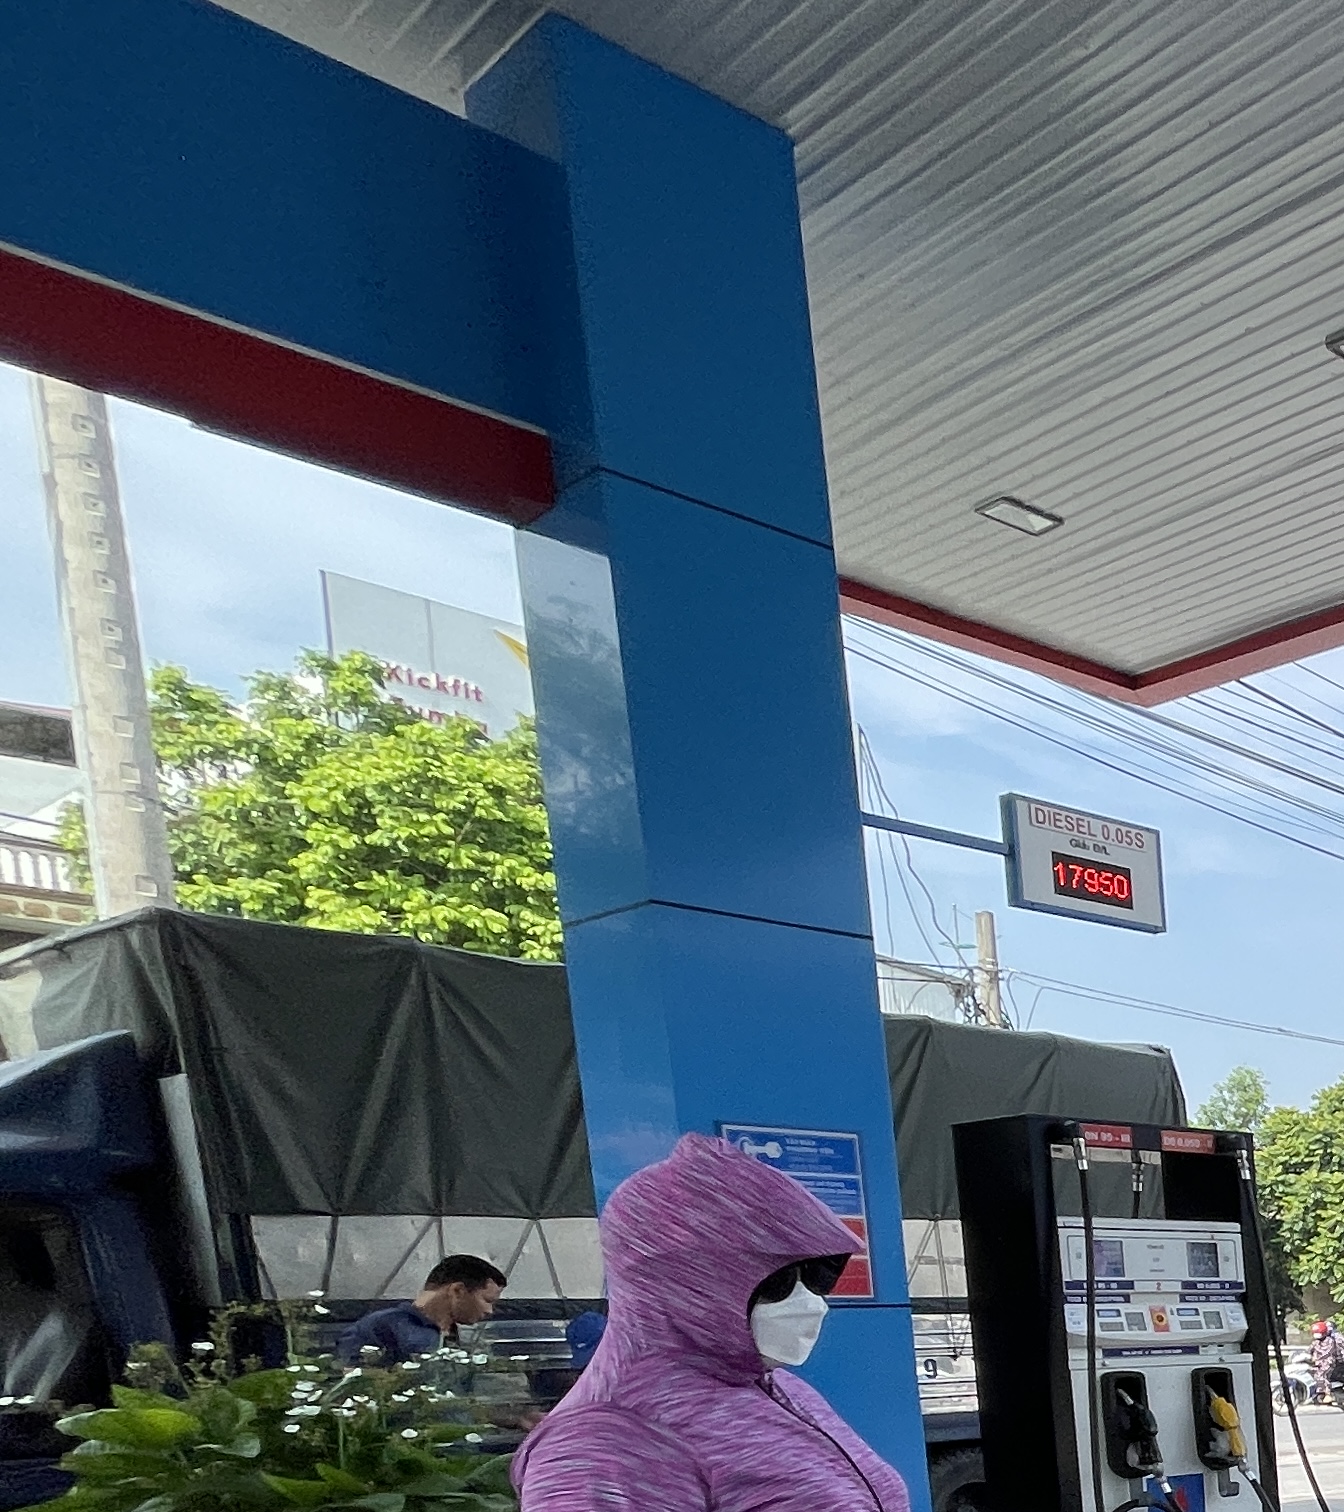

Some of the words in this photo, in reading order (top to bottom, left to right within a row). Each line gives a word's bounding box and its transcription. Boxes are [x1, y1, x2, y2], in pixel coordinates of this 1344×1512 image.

[1034, 806, 1098, 839] DIESEL
[1101, 823, 1146, 850] 0.05S
[1053, 861, 1130, 900] 17950
